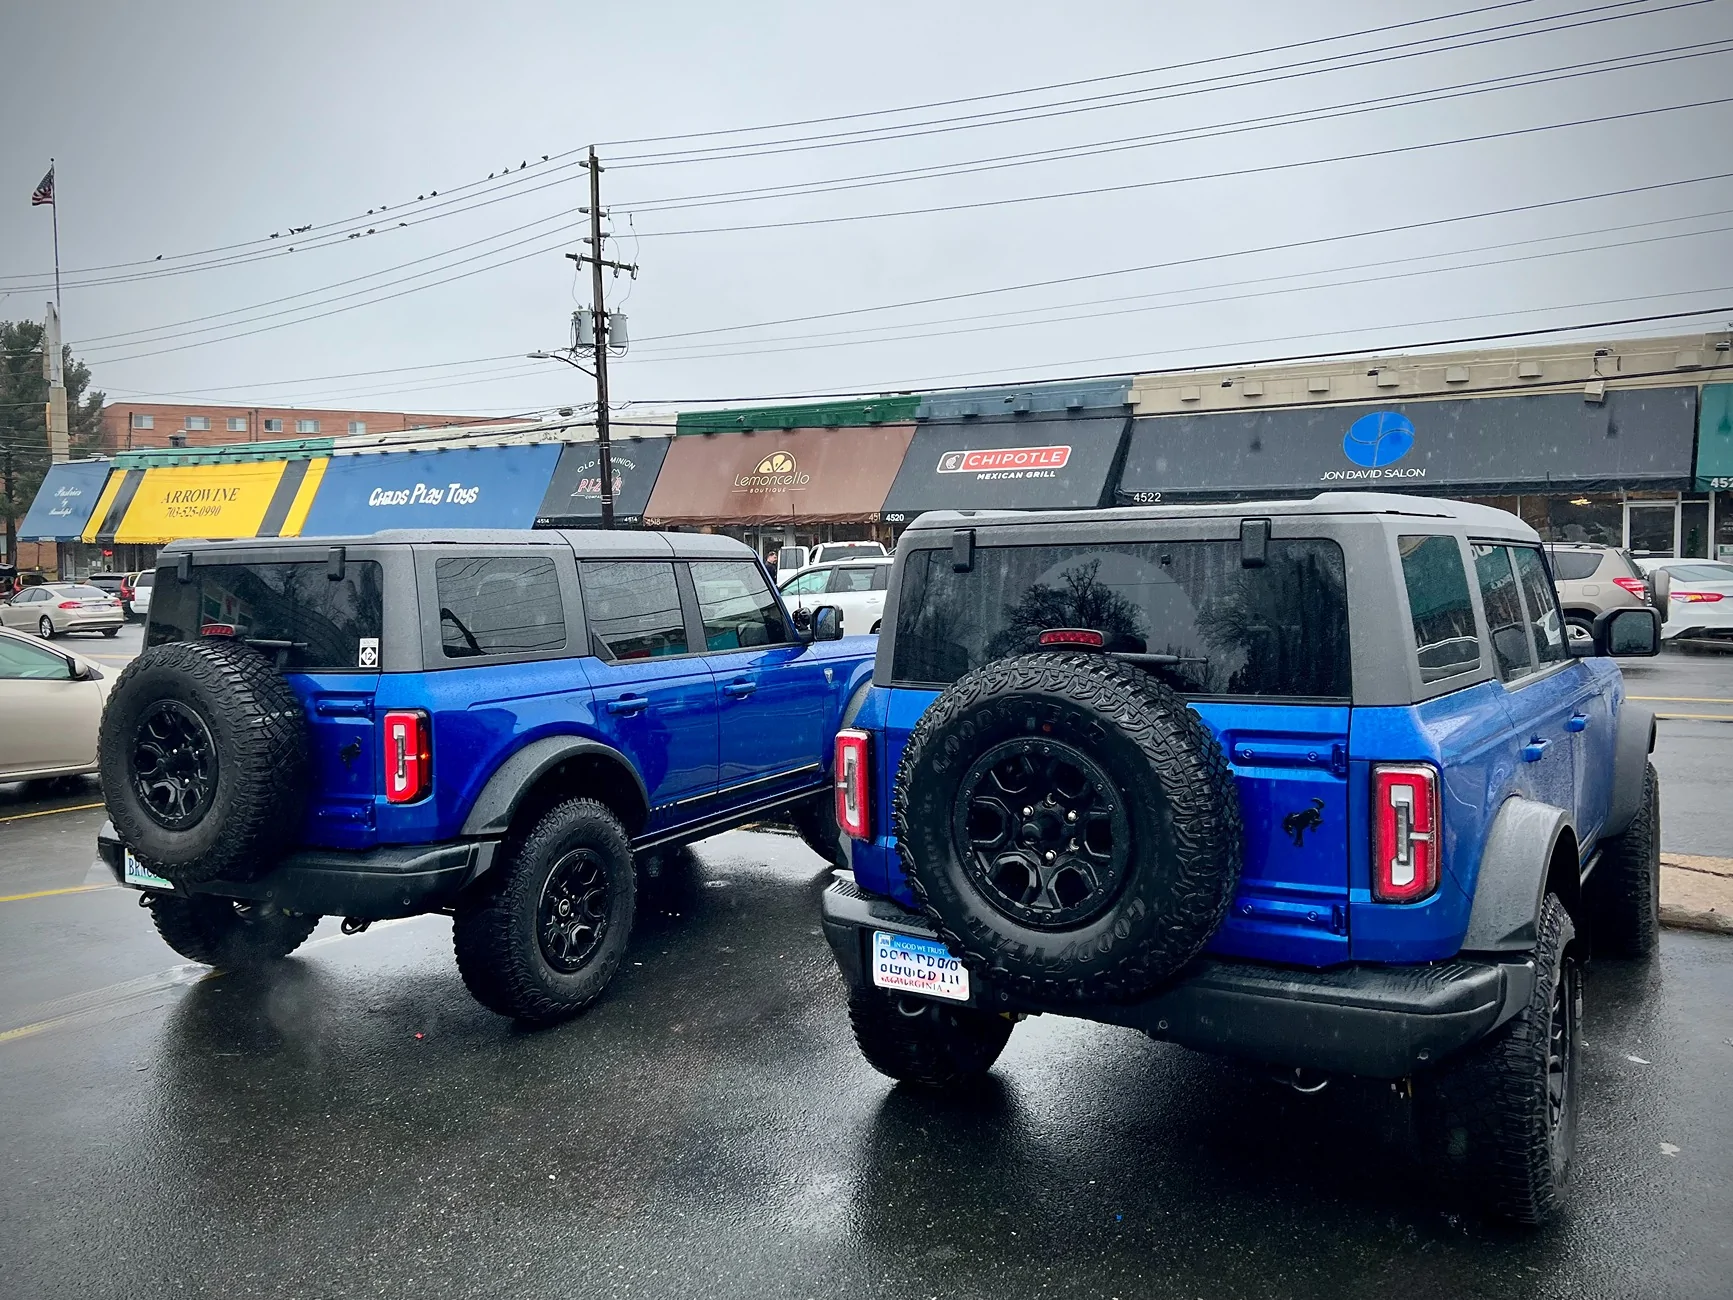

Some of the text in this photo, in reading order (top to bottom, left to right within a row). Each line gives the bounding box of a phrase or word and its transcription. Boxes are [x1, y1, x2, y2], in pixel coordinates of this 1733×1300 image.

[577, 456, 636, 473] OLD DMINION
[967, 450, 1064, 467] CHIPOTLE
[734, 471, 810, 487] Lemoncello
[976, 469, 1056, 481] MEXICAN GRILL
[1320, 467, 1426, 481] JON DAVID SALON
[577, 477, 623, 493] PIZA
[749, 486, 787, 494] BOUTIQUE
[160, 487, 241, 504] ARROWINE
[1133, 492, 1162, 503] 4522
[163, 504, 222, 519] 703-525-0990
[885, 512, 905, 522] 4520
[364, 652, 373, 661] 12
[901, 942, 917, 950] GOD
[916, 944, 926, 952] WE
[927, 946, 946, 956] TRUST
